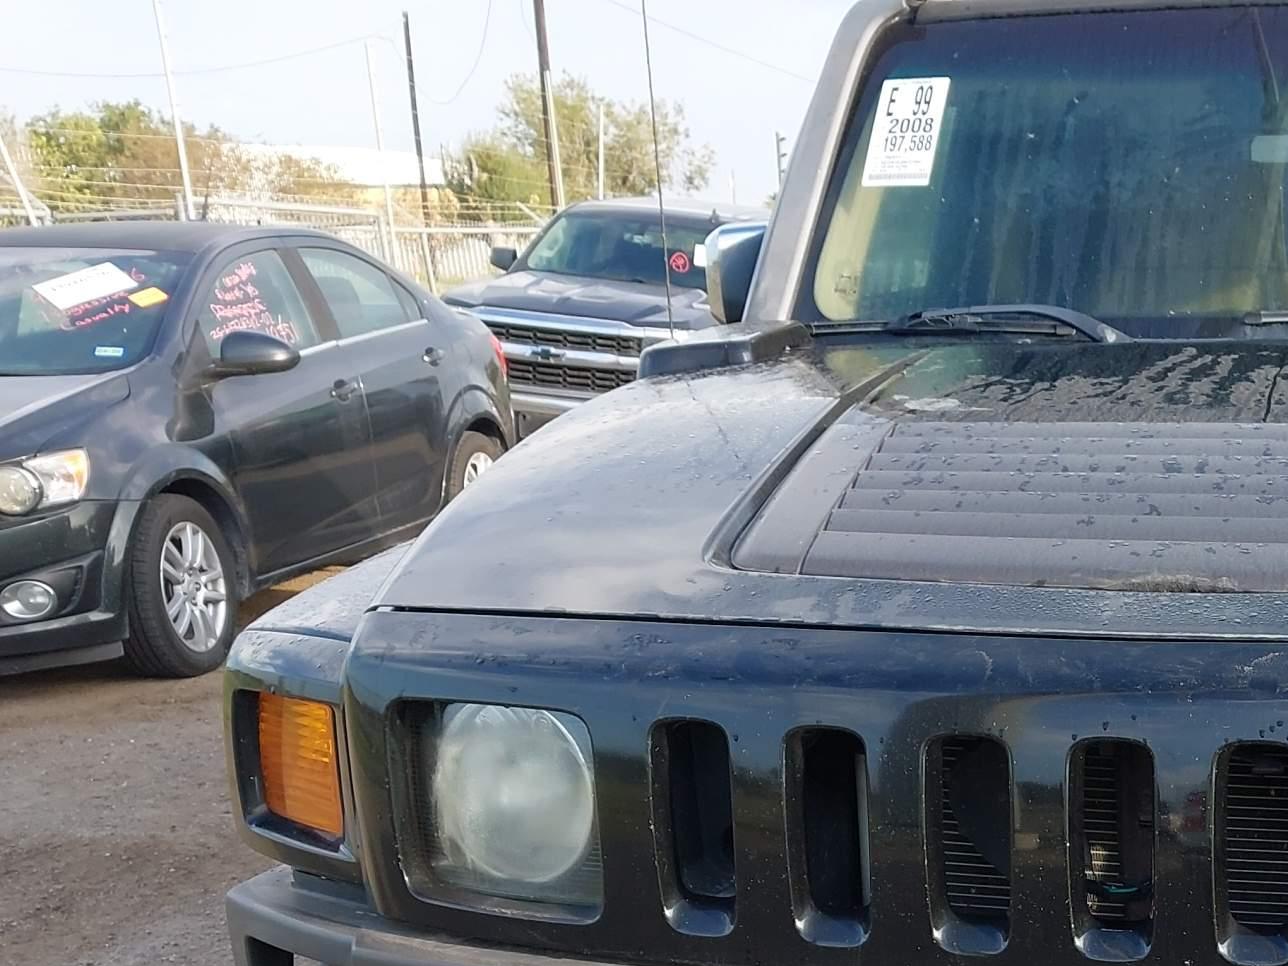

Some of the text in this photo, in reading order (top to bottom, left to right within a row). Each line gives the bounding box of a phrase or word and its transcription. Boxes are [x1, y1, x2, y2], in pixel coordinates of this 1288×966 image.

[886, 85, 933, 116] E 99
[888, 117, 935, 135] 2008
[884, 135, 933, 153] 197,588
